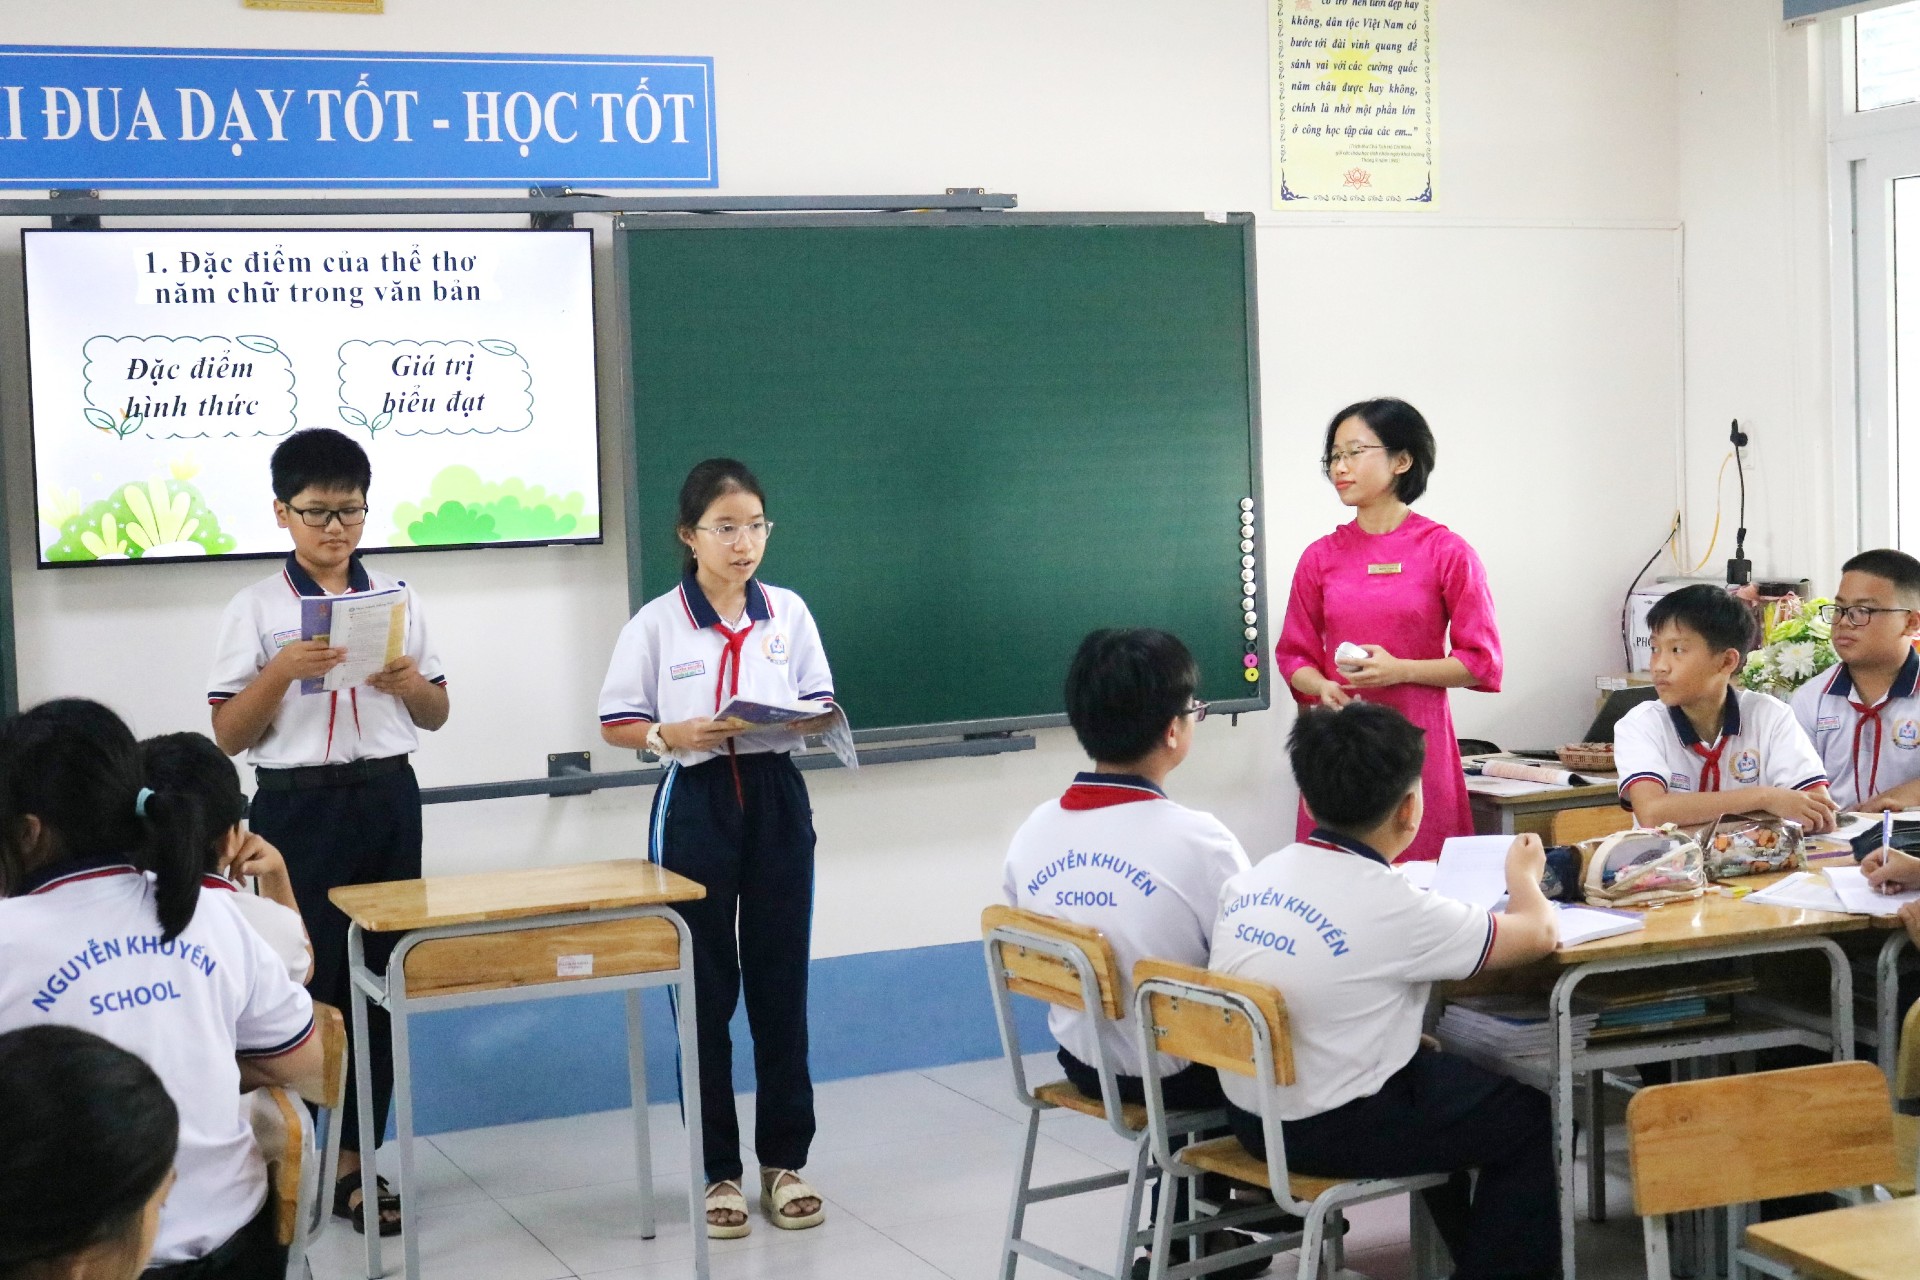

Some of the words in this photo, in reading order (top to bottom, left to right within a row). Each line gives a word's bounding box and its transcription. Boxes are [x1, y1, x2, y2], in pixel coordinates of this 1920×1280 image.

[1404, 0, 1419, 11] hay
[1291, 15, 1322, 29] không,
[1326, 16, 1342, 27] dân
[1363, 17, 1380, 31] Việt
[1383, 19, 1403, 30] Nam
[1351, 39, 1370, 50] vinh
[1375, 42, 1402, 53] quang
[1316, 60, 1329, 70] vai
[1315, 81, 1336, 92] châu
[1368, 83, 1384, 95] hay
[1389, 83, 1418, 97] không,
[41, 86, 168, 142] ĐUA
[176, 87, 294, 157] DẠY
[307, 73, 418, 143] TỐT
[462, 90, 578, 157] HỌC
[591, 77, 694, 145] TỐT
[1291, 102, 1316, 113] chính
[1302, 124, 1321, 137] công
[146, 251, 168, 274] 1.
[179, 252, 234, 280] Đặc
[244, 243, 312, 274] điểm
[323, 251, 370, 274] của
[380, 244, 421, 273] thể
[432, 251, 478, 273] thơ
[155, 281, 216, 305] năm
[227, 280, 281, 304] chữ
[289, 282, 364, 308] trong
[375, 281, 422, 303] văn
[432, 279, 481, 302] bản
[126, 357, 184, 387] Đặc
[190, 349, 254, 380] điểm
[391, 354, 439, 377] Giá
[445, 353, 475, 381] trị
[126, 395, 187, 419] hình
[198, 393, 260, 417] thức
[382, 385, 441, 415] biểu
[446, 391, 486, 417] đạt
[1027, 849, 1087, 896] NGUYỄN
[1090, 852, 1157, 897] KHUYẾN
[1055, 891, 1118, 907] SCHOOL
[1222, 886, 1285, 921] NGUYỄN
[1285, 895, 1349, 958] KHUYẾN
[1234, 924, 1297, 956] SCHOOL
[32, 938, 122, 1012] NGUYỄN
[89, 980, 182, 1016] SCHOOL
